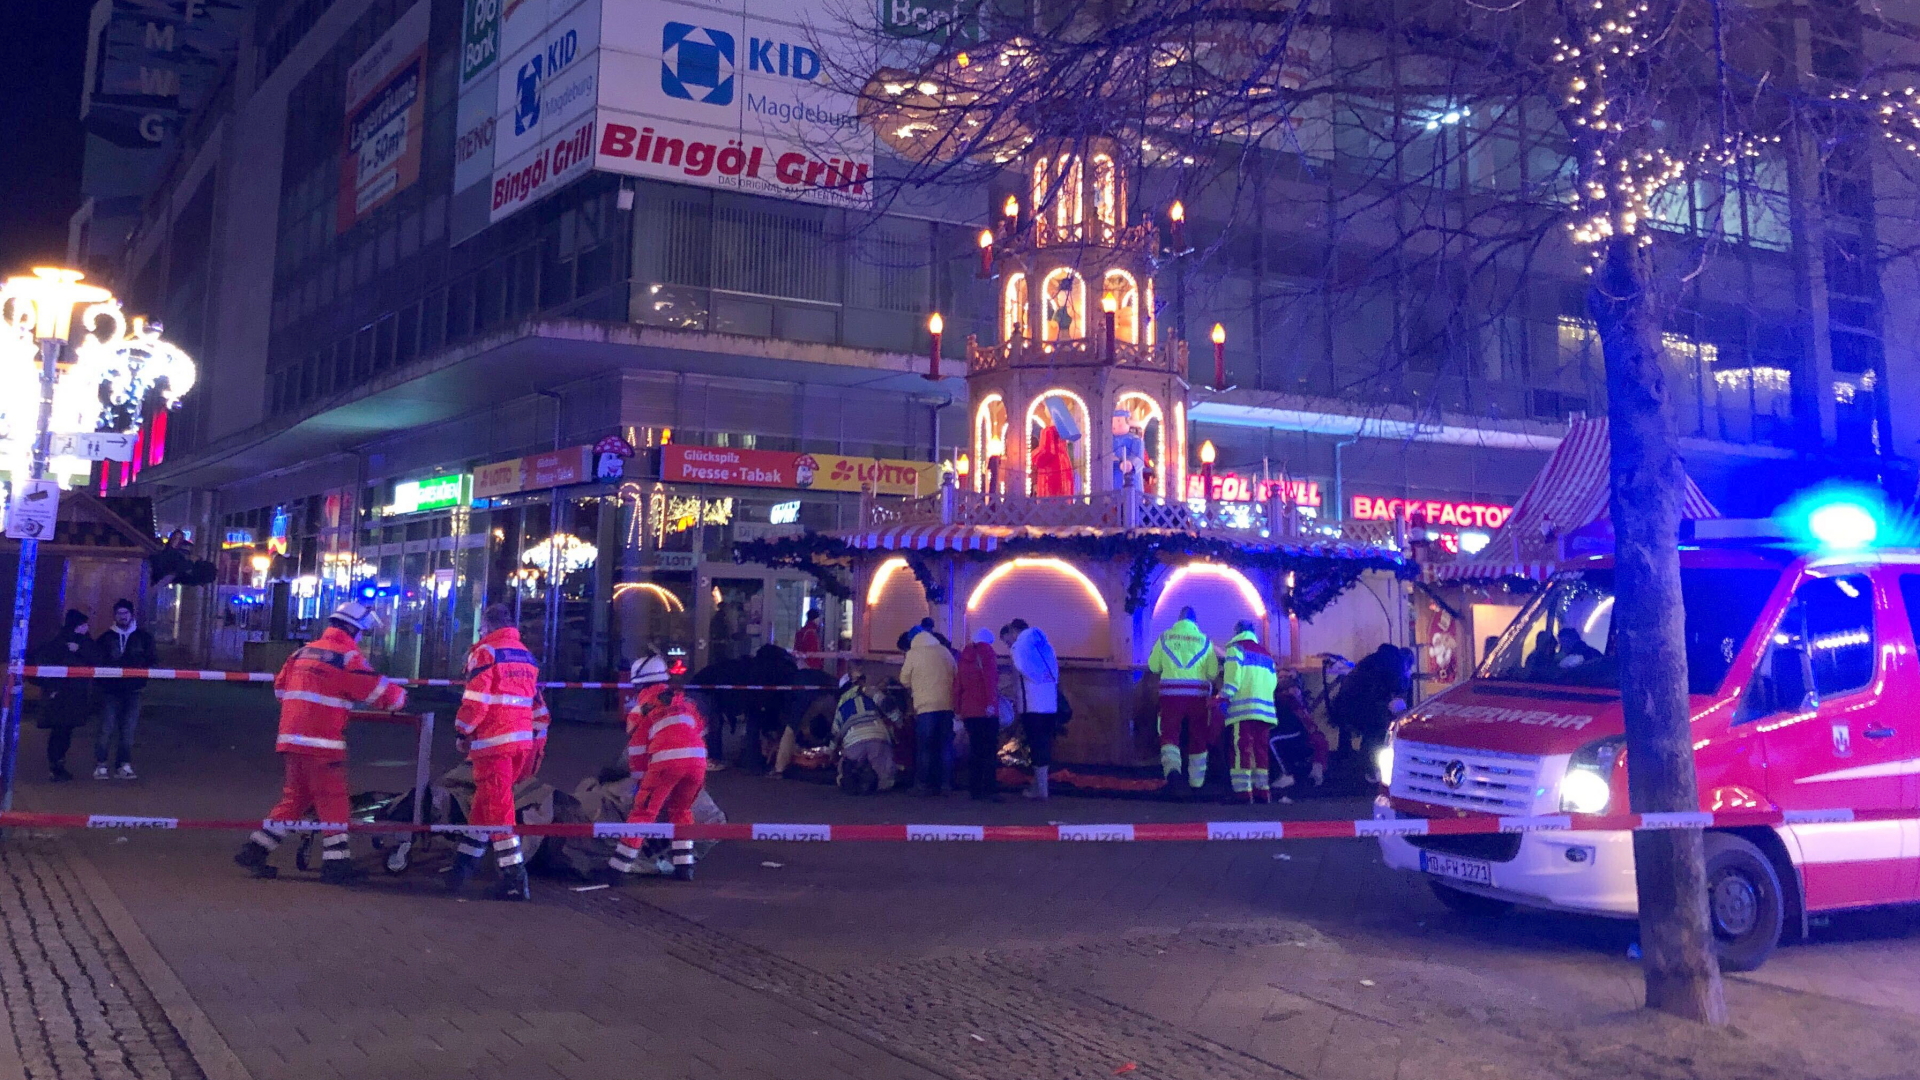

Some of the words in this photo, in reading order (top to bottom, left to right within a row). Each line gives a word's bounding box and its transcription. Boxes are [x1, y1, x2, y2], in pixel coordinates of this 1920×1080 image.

[465, 28, 495, 72] Bank
[548, 29, 577, 77] KID
[749, 37, 821, 80] KID
[546, 76, 593, 118] Magdeburg
[747, 93, 860, 132] Magdeburg
[456, 117, 496, 165] RENO
[599, 123, 763, 178] Bingöl
[776, 151, 868, 195] Grill
[493, 148, 550, 210] Bingöl
[553, 121, 594, 176] Grill
[718, 176, 737, 187] DAS
[739, 179, 782, 193] ORIGINAL
[682, 465, 729, 480] Presse
[740, 467, 782, 483] Tabak
[683, 450, 740, 465] Glückspilz
[857, 464, 917, 485] LOTTO
[1461, 862, 1488, 880] 1271
